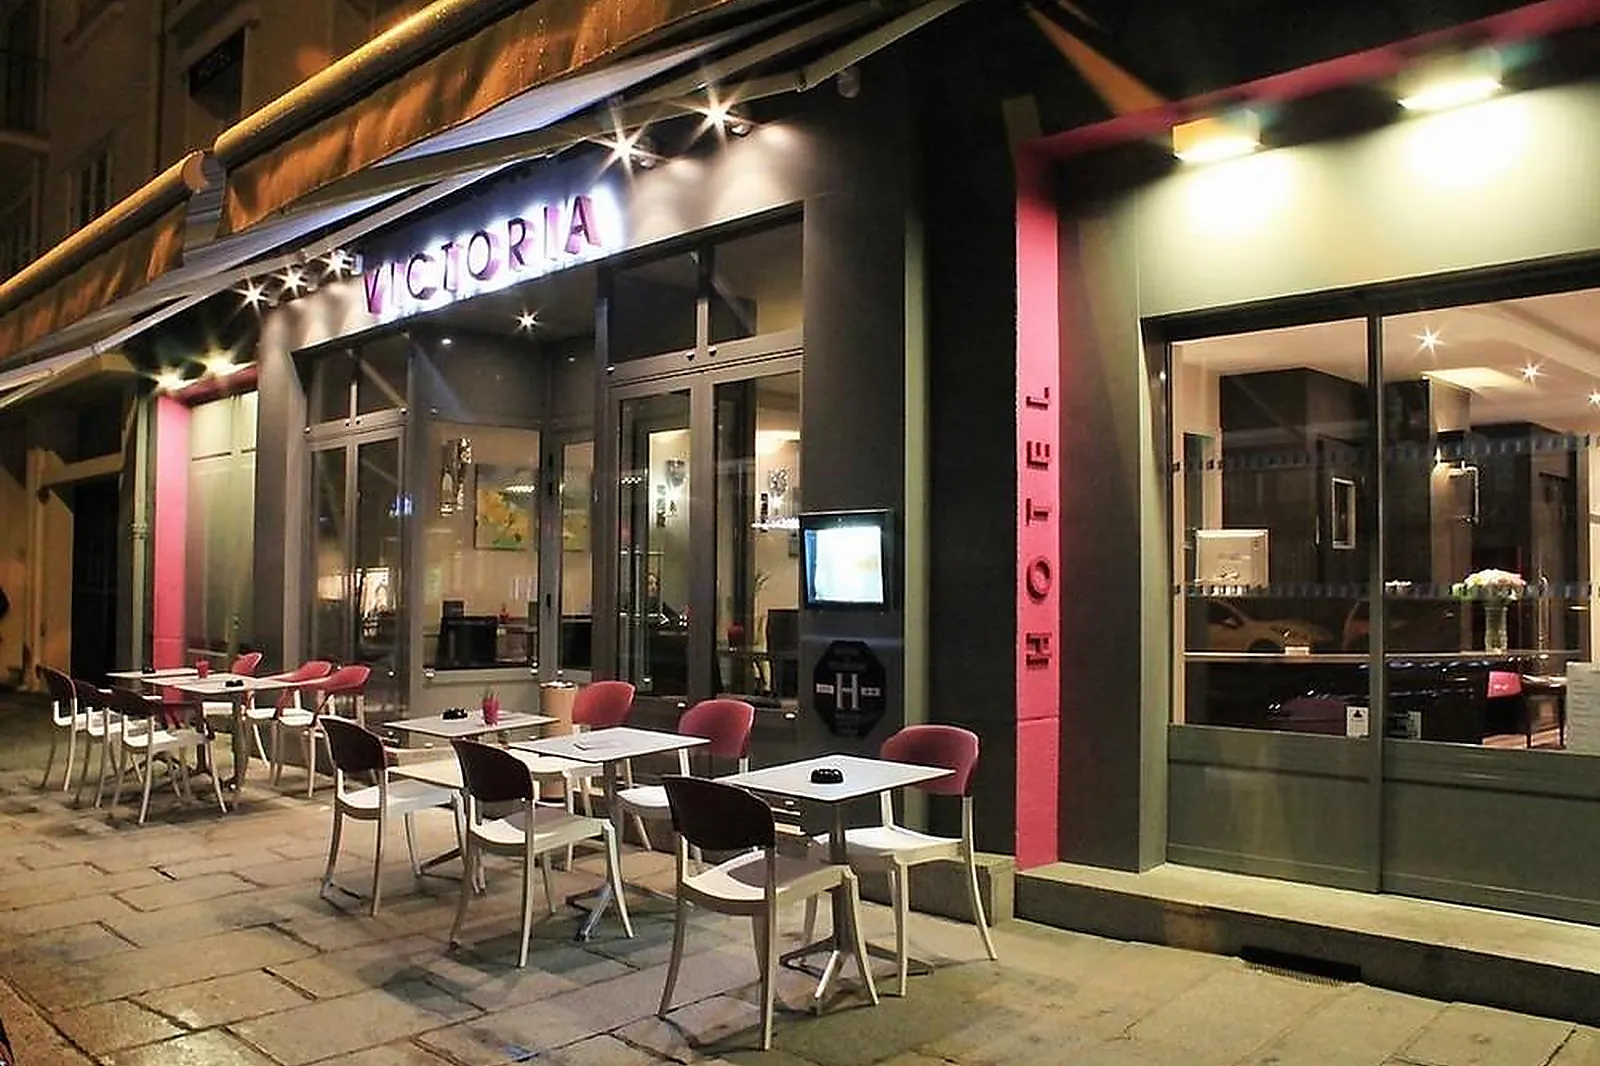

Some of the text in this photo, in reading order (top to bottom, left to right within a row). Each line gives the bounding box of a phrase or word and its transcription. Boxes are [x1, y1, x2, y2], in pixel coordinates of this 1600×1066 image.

[363, 195, 601, 315] VICTORIA
[1026, 387, 1051, 668] HOTEL
[836, 673, 859, 709] H
